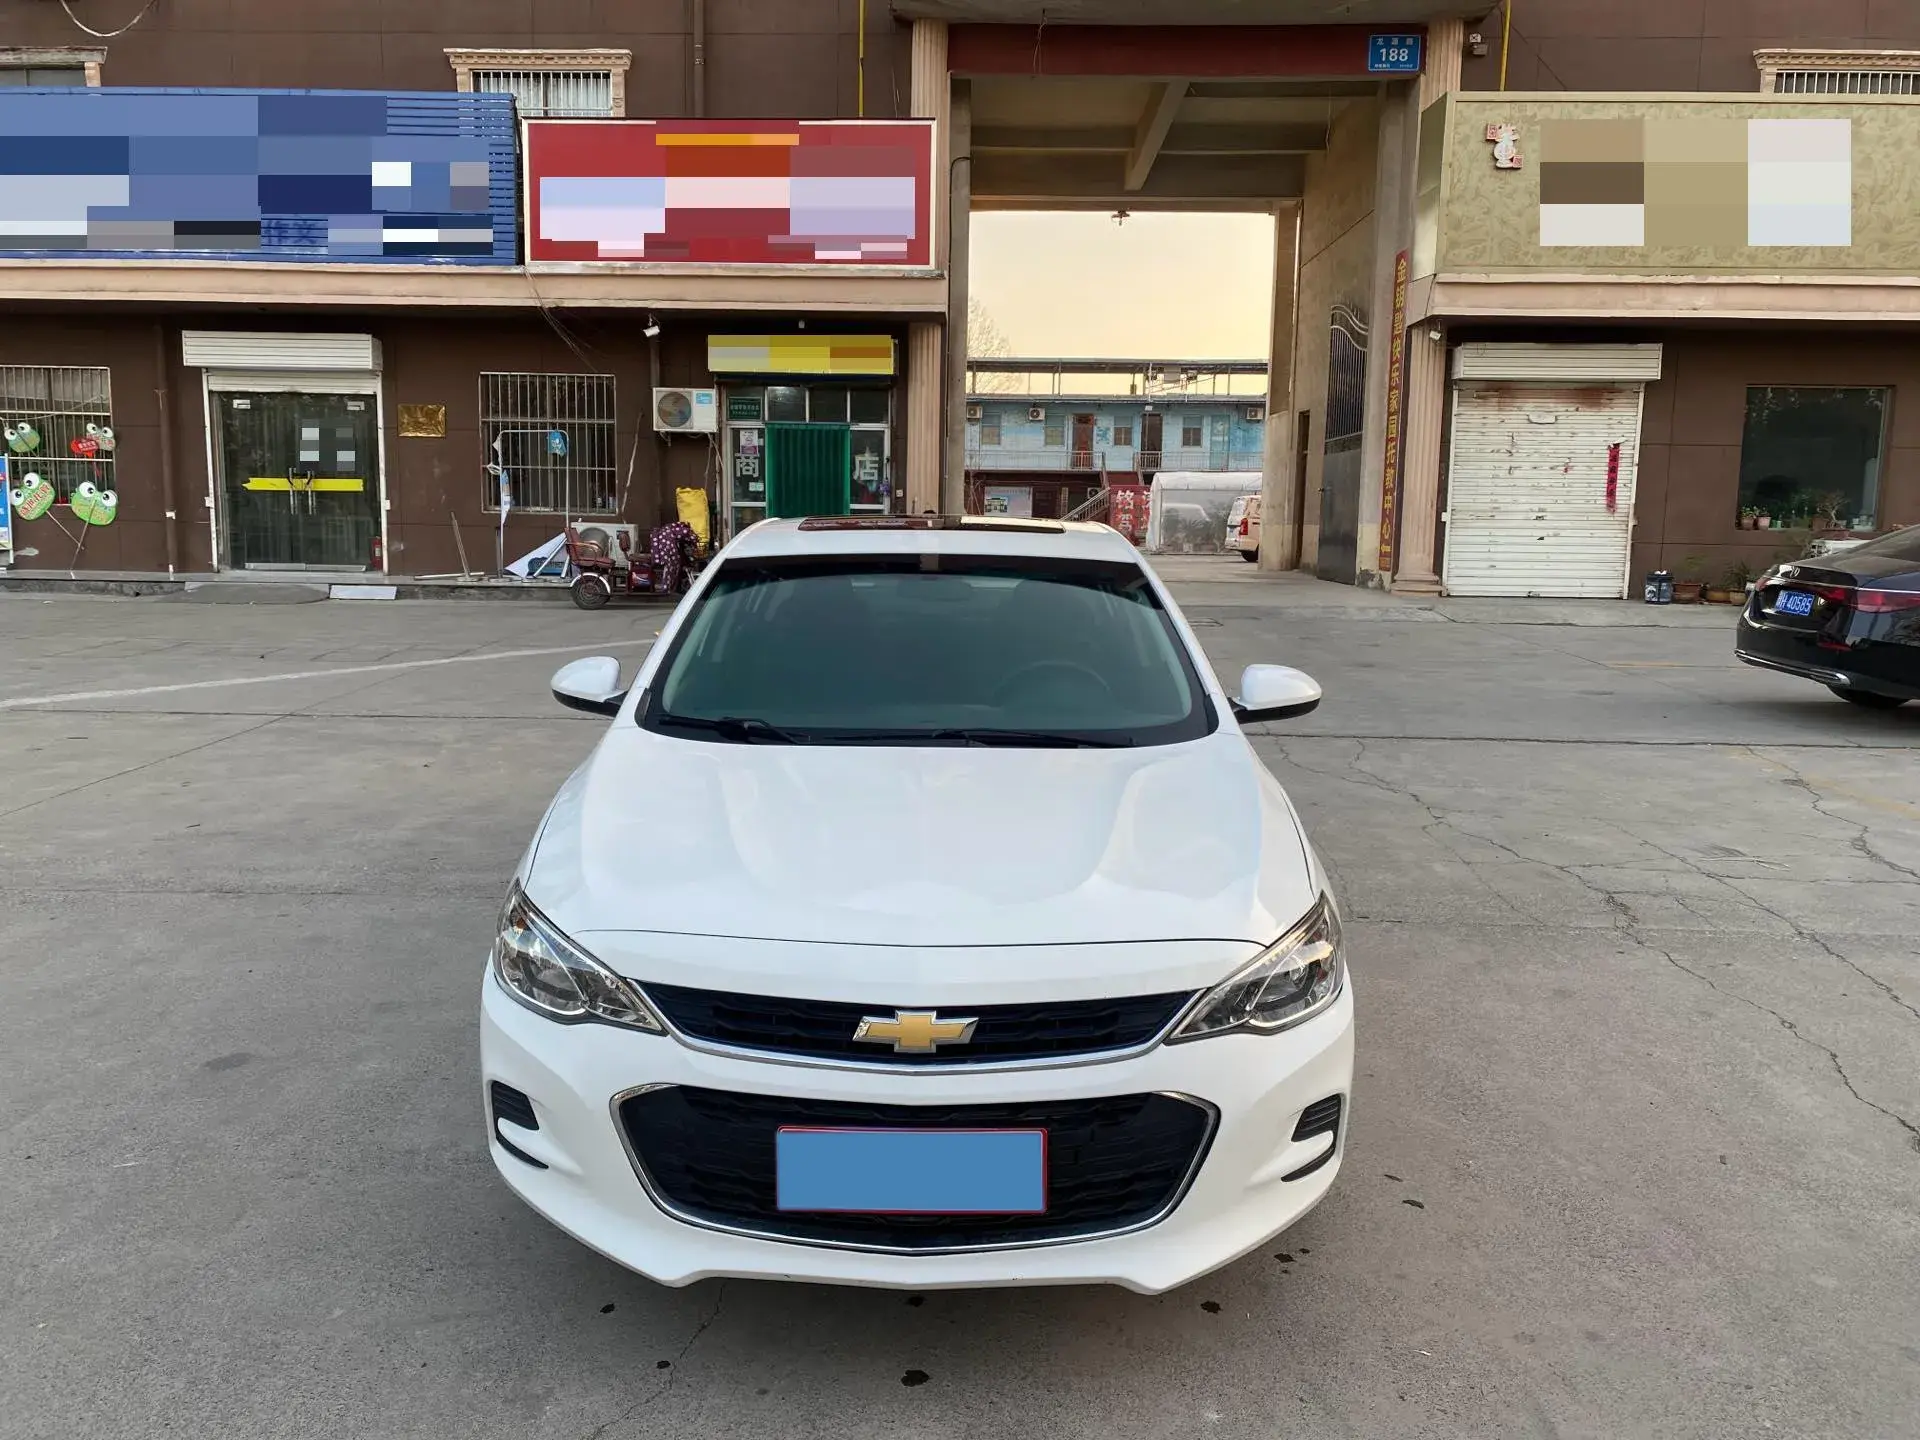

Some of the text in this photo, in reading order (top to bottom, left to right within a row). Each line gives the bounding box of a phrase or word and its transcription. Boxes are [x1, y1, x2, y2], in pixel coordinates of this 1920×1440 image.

[1379, 47, 1409, 62] 188
[734, 449, 880, 481] 商 店
